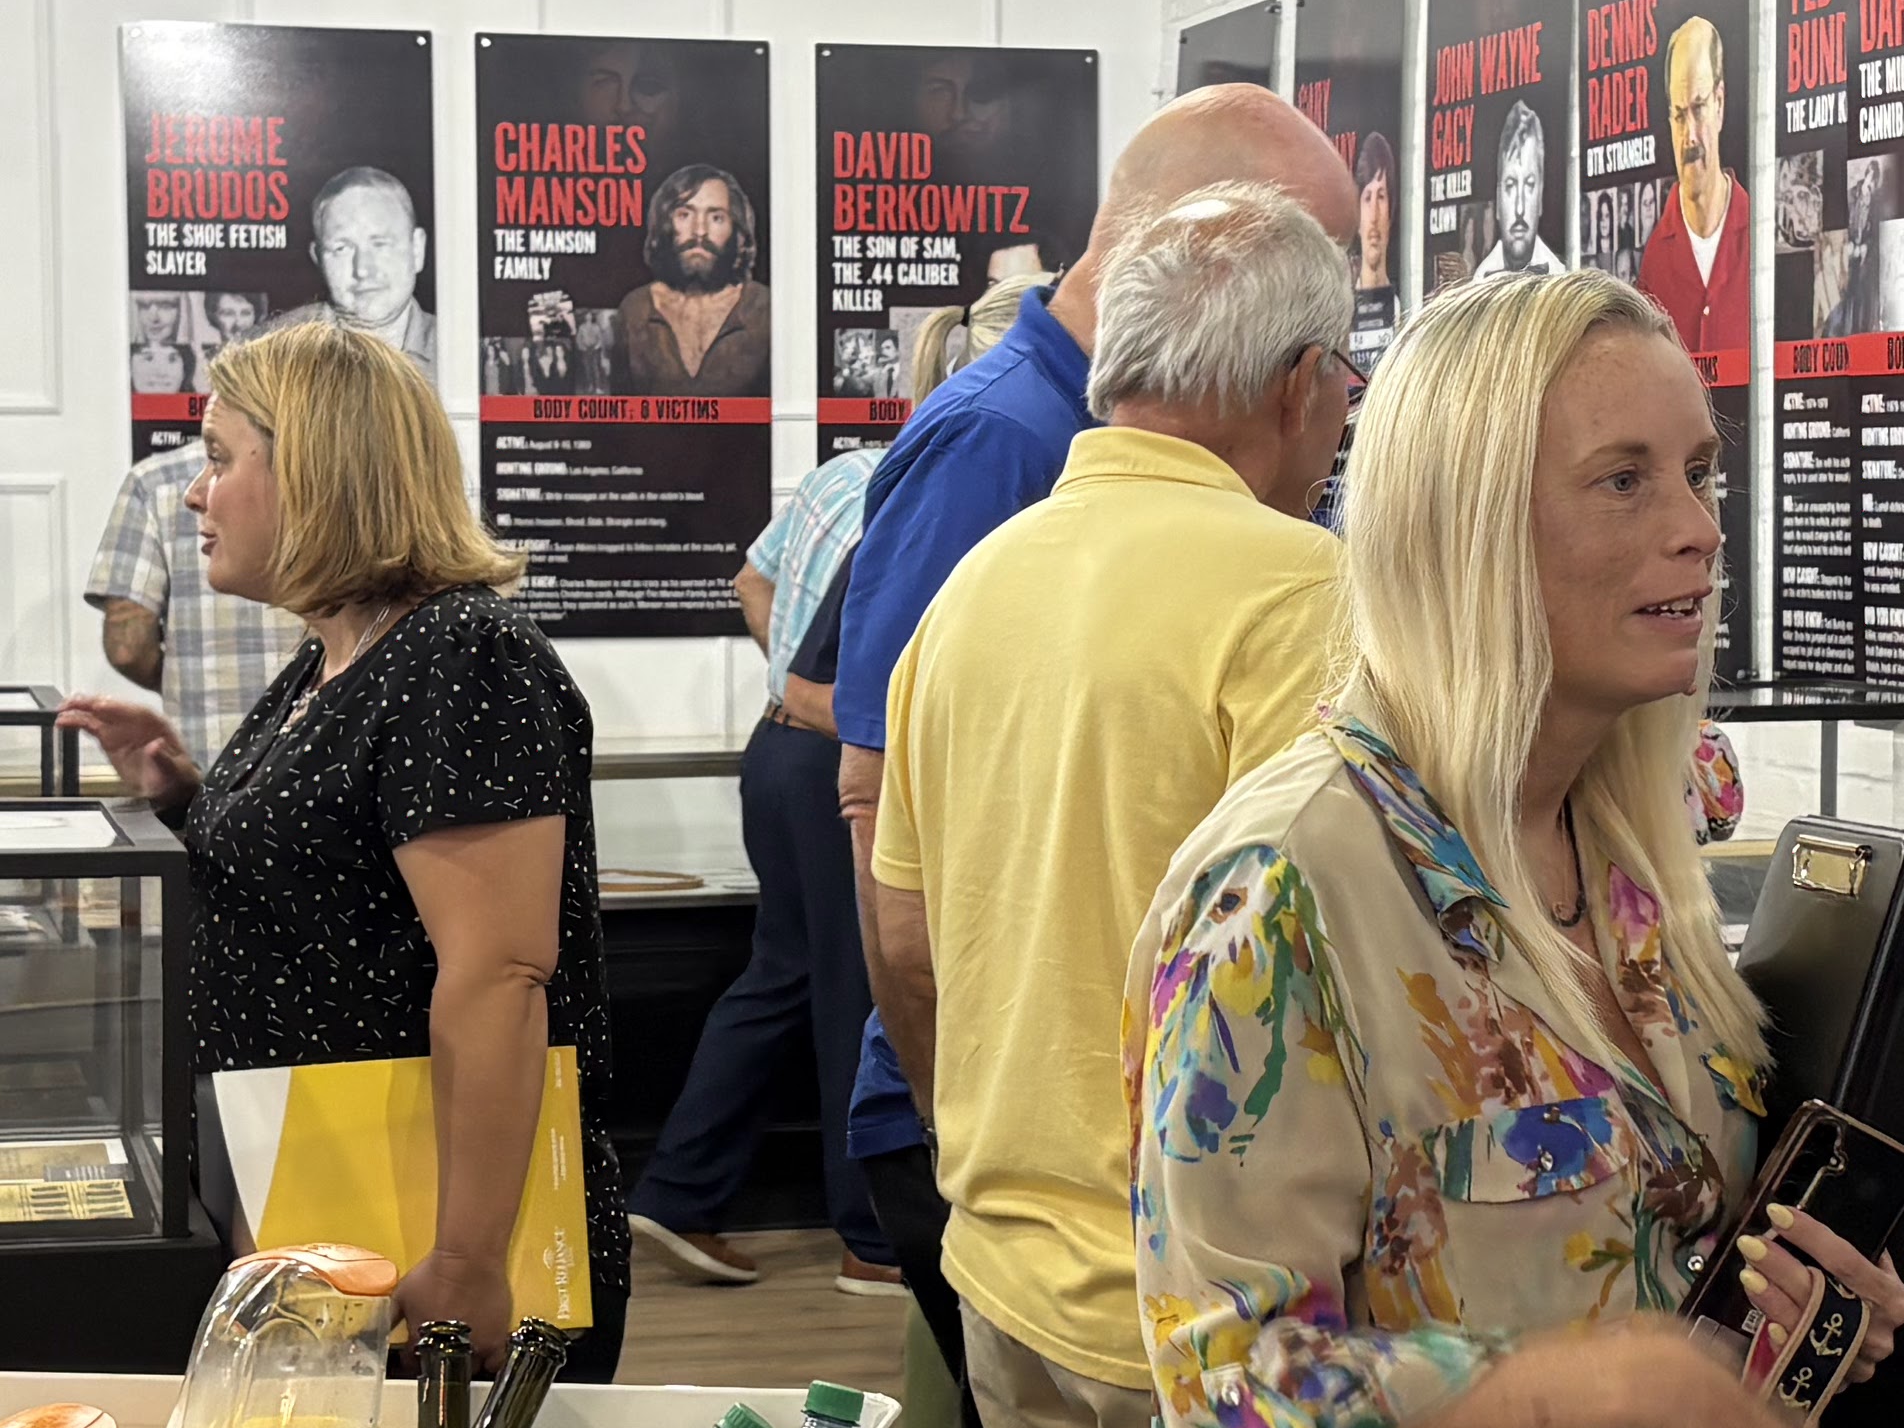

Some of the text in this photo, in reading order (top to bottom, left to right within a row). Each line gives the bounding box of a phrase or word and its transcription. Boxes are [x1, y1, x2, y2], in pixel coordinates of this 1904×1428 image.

[1433, 21, 1543, 106] JOHN WAYNE
[1858, 62, 1882, 98] THE
[1587, 66, 1649, 141] RADER
[1786, 93, 1835, 133] THE LADY
[144, 112, 287, 166] JEROME
[494, 122, 647, 174] CHARLES
[833, 130, 932, 179] DAVID
[1431, 104, 1475, 170] GACY
[1586, 135, 1656, 178] BTK STRANGLER
[145, 169, 289, 221] BRUDOS
[495, 175, 643, 227] MANSON
[1430, 175, 1446, 202] THE
[832, 183, 1030, 233] BERKOWITZ
[146, 222, 287, 249] THE SHOE FETISH
[494, 228, 596, 254] THE MANSON
[832, 236, 961, 262] THE SON OF SAM,
[146, 251, 207, 275] SLAYER
[494, 256, 551, 280] FAMILY
[832, 262, 959, 285] THE .44 CALIBER
[832, 288, 883, 312] KILLER
[533, 399, 571, 419] BODY
[578, 400, 634, 420] COUNT:
[656, 400, 719, 420] VICTIMS
[870, 401, 905, 421] BODY
